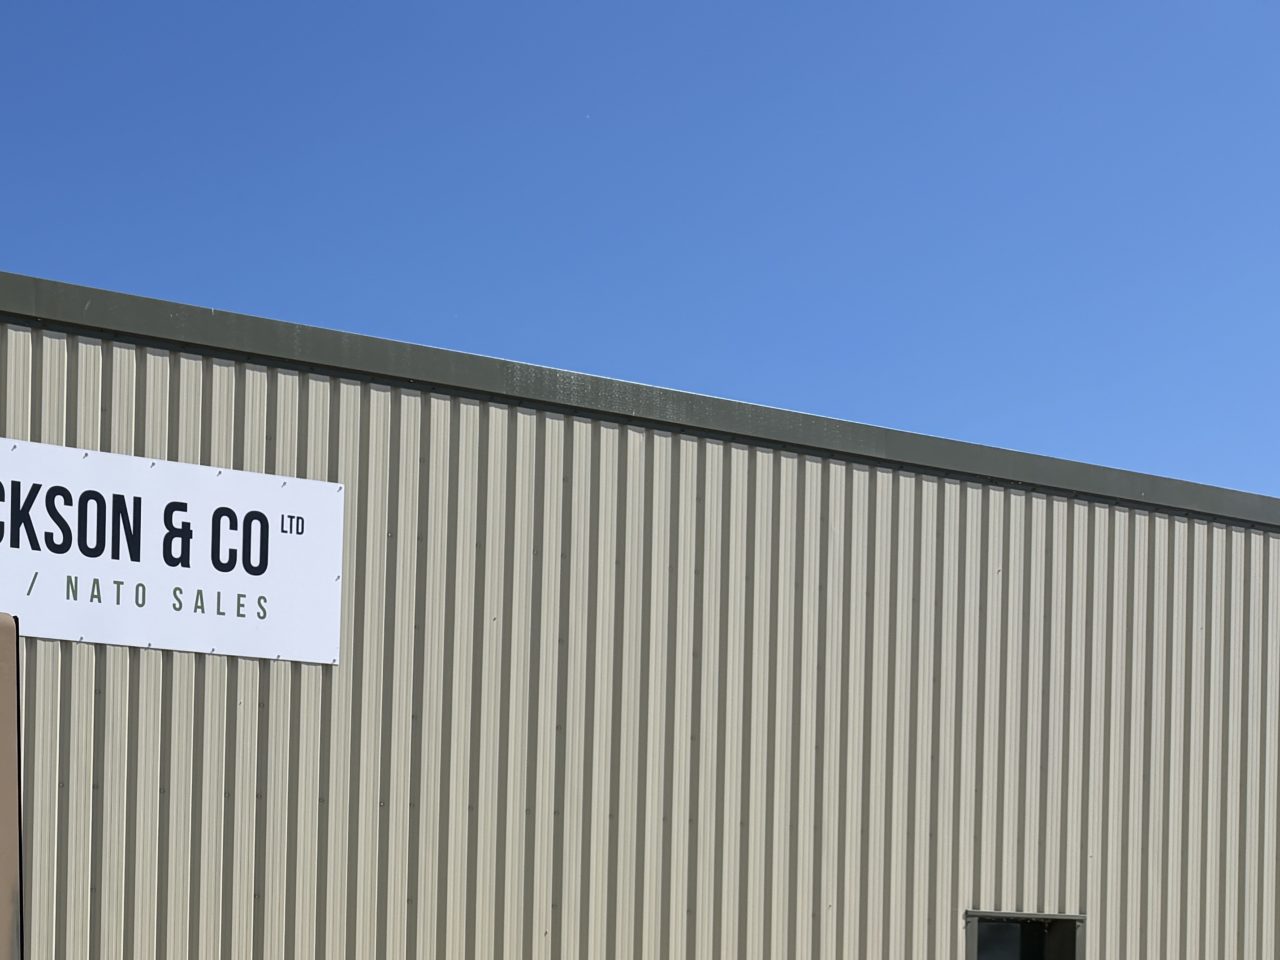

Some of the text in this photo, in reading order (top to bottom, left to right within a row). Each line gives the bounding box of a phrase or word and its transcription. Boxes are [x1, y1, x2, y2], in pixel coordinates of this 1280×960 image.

[162, 501, 193, 568] &
[211, 506, 270, 577] CO
[280, 514, 305, 535] LTD
[27, 572, 39, 596] /
[66, 575, 146, 608] NATO
[172, 586, 268, 620] SALES
